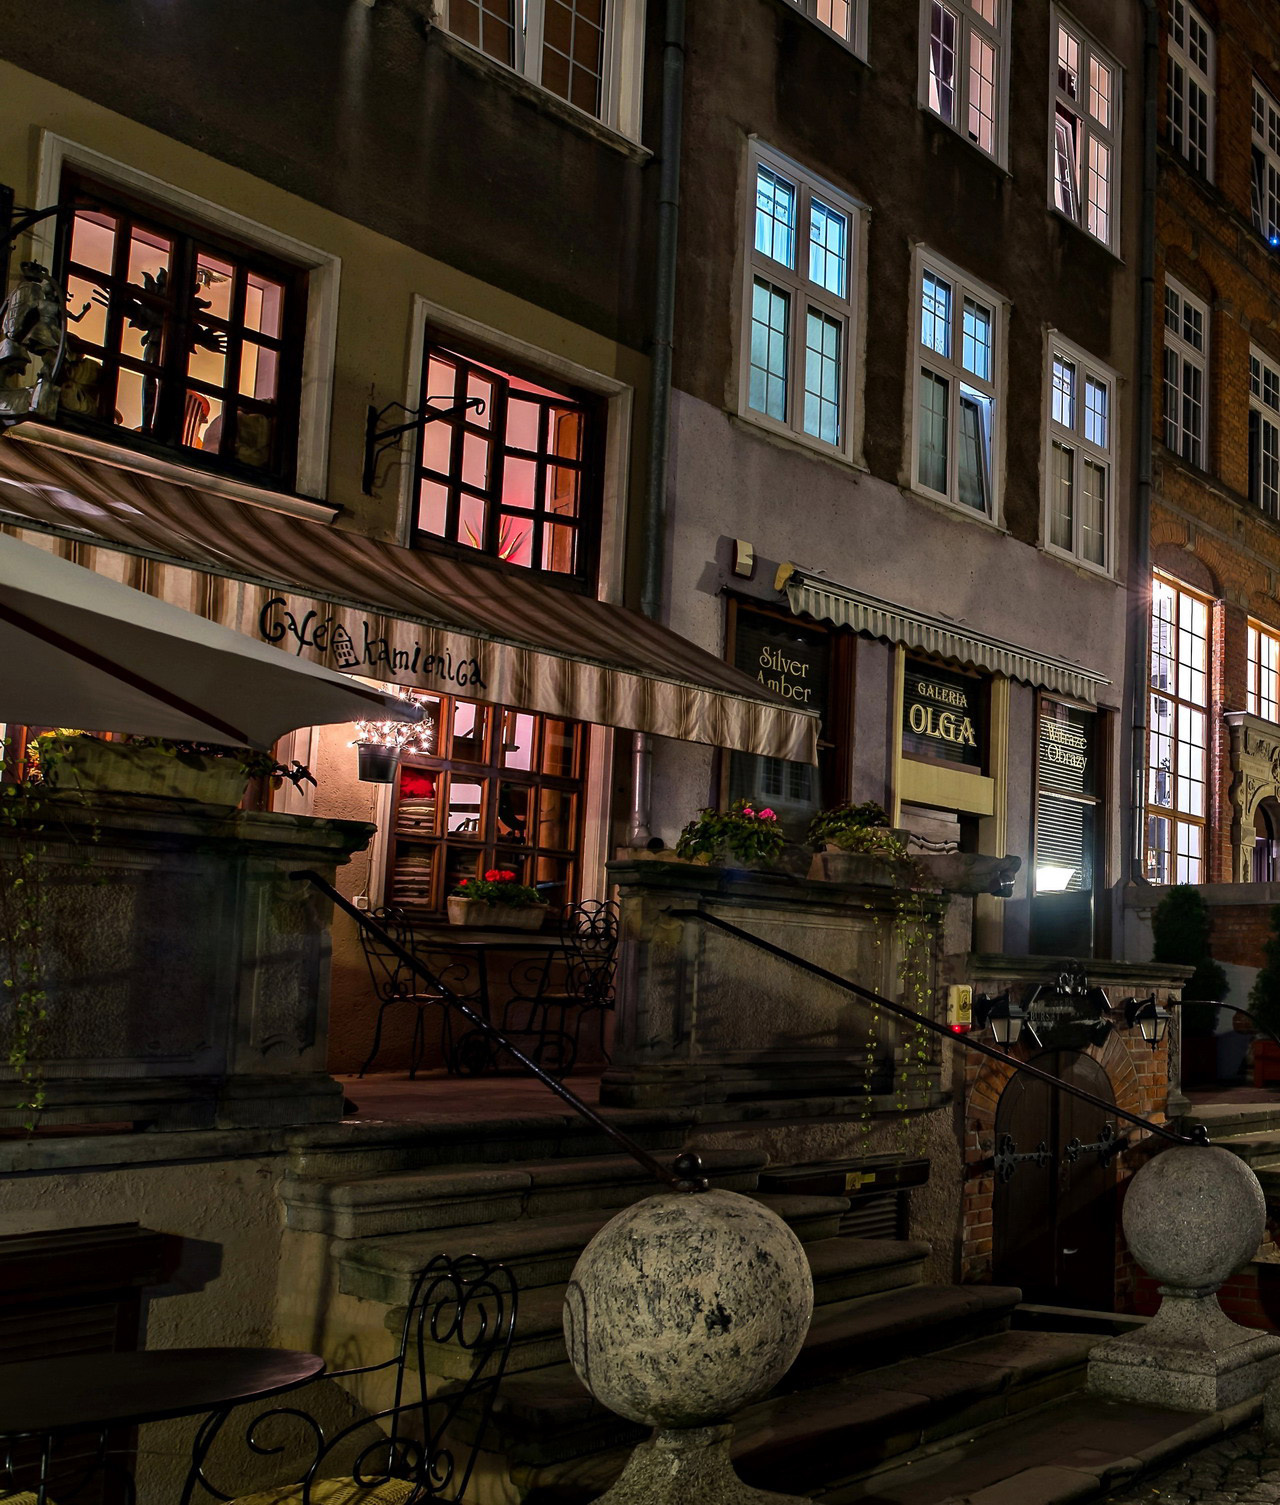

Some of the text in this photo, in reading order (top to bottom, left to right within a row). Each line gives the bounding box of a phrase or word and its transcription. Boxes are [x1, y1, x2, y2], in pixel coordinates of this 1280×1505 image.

[759, 646, 810, 678] Silver
[757, 670, 812, 702] Amber
[917, 682, 969, 708] GALERIA
[909, 703, 978, 747] OLGA
